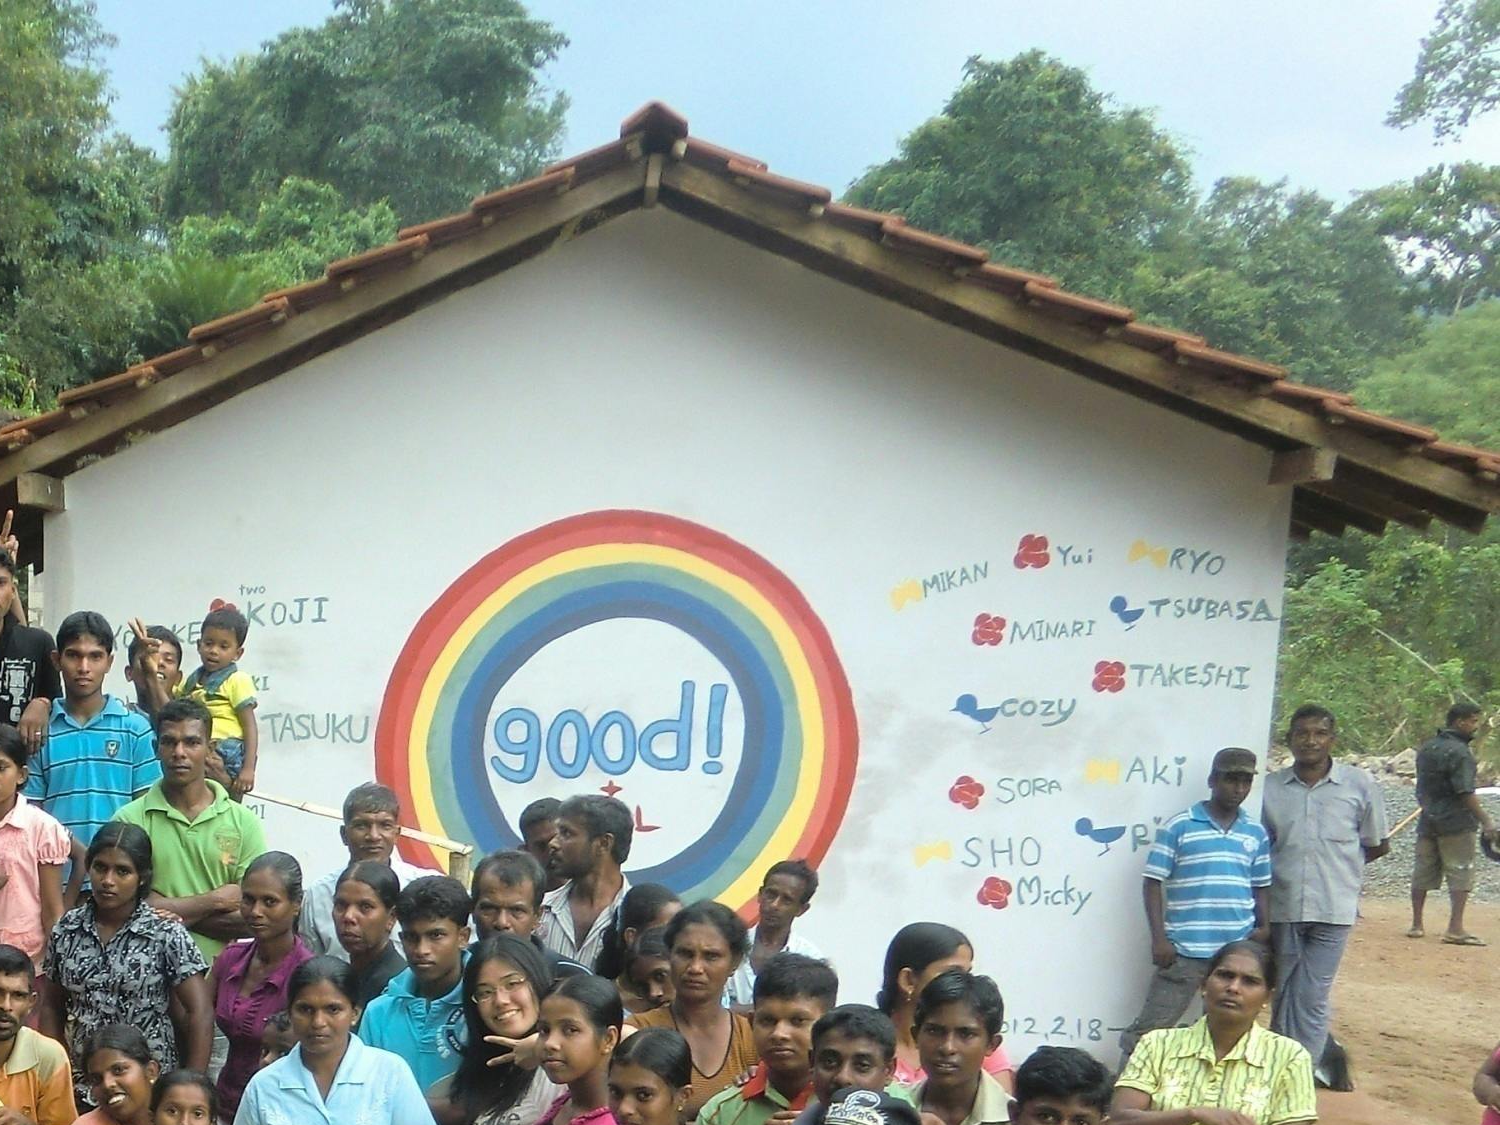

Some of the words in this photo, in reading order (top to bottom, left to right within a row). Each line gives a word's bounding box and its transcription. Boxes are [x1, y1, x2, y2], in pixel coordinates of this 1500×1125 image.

[1056, 546, 1094, 568] Yui
[1168, 547, 1227, 576] RYO
[238, 583, 266, 595] two
[921, 561, 989, 598] MIKAN
[246, 596, 329, 627] KOJI
[1148, 598, 1280, 623] TSUBASA
[1009, 619, 1096, 645] MINARI
[1130, 663, 1252, 690] TAKESHI
[260, 713, 370, 744] TASUKU
[490, 680, 729, 784] good!
[1125, 756, 1187, 787] Aki
[995, 778, 1062, 804] SORA
[961, 836, 1042, 869] SHO
[1016, 875, 1093, 916] Micky
